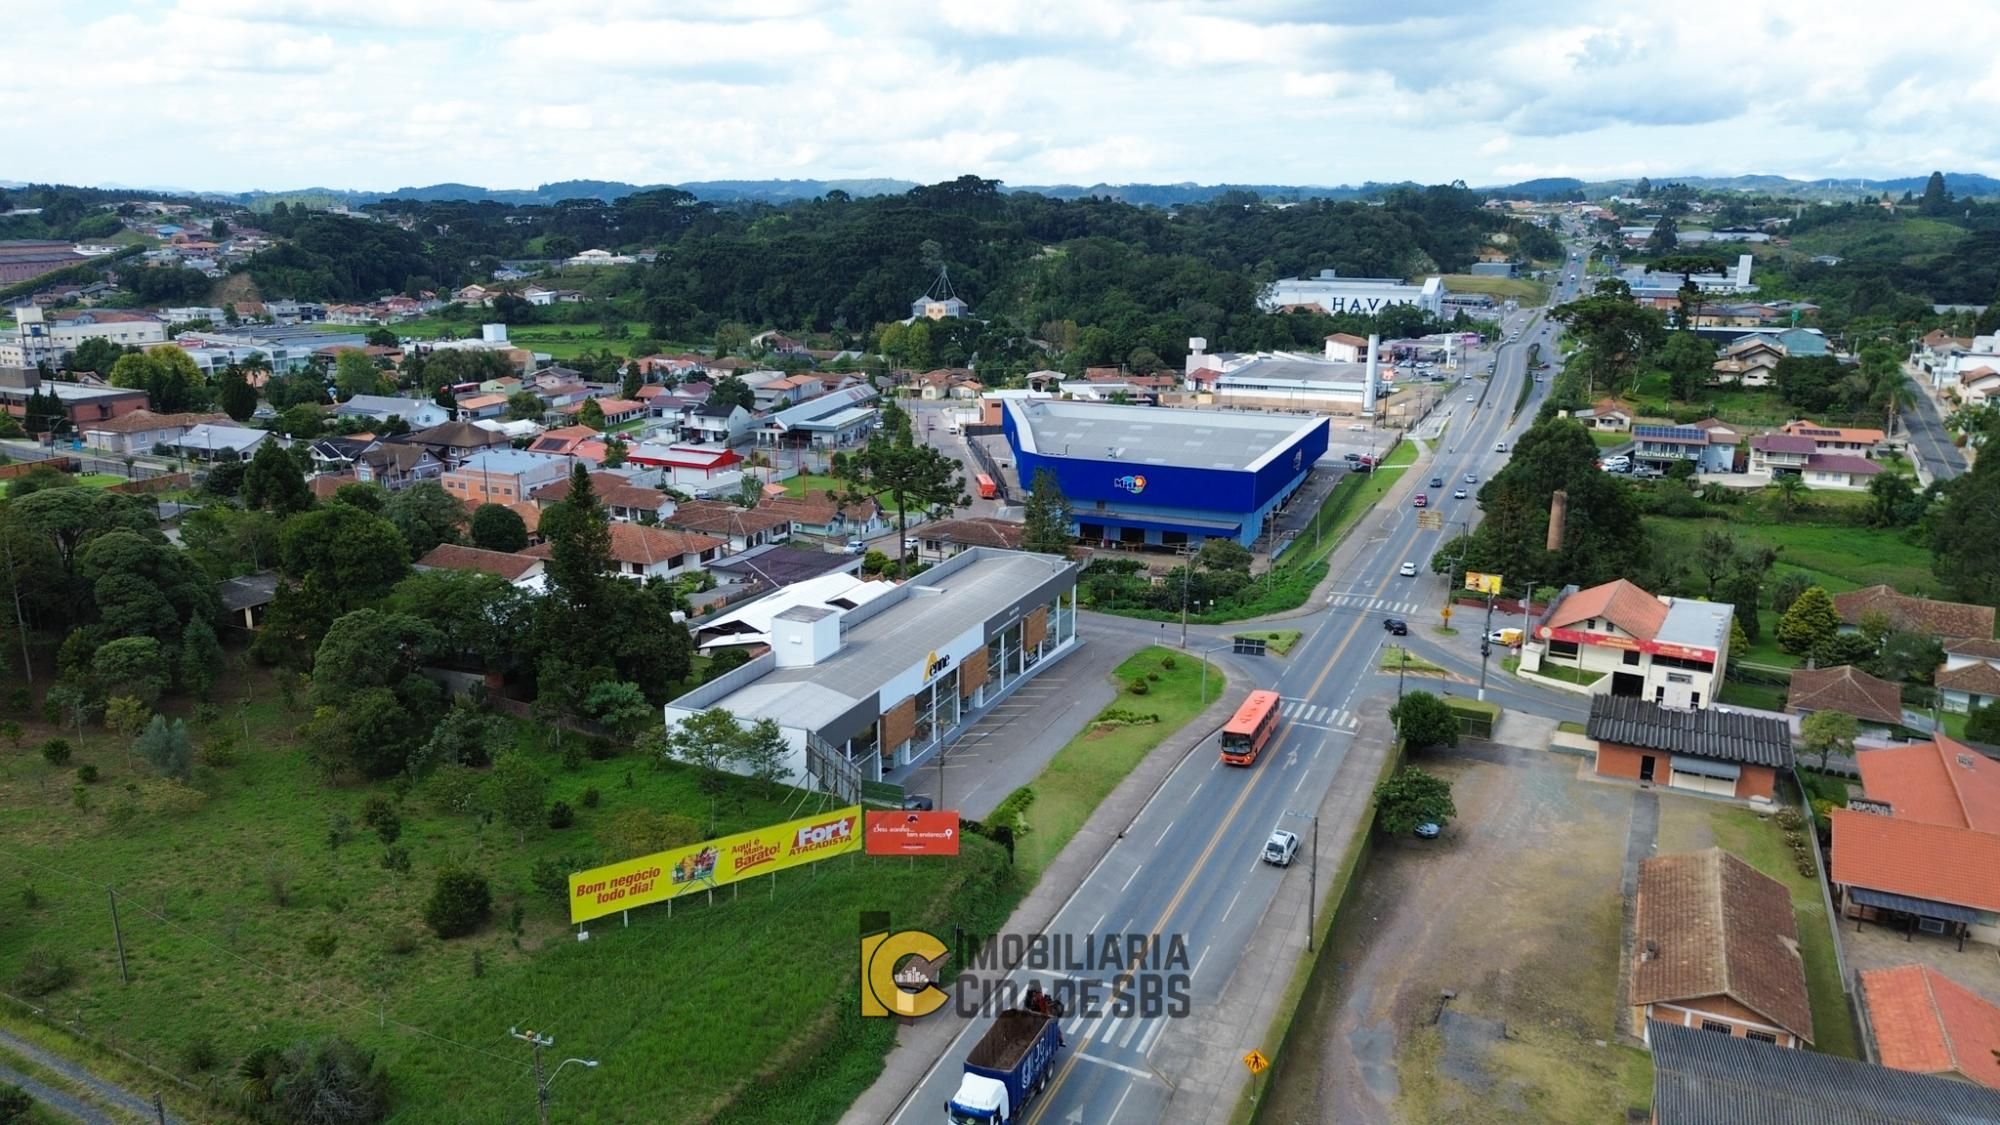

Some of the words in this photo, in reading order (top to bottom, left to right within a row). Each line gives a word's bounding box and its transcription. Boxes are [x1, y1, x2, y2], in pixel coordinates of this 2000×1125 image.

[1635, 451, 1684, 459] MULTIMARCAS
[798, 819, 849, 847] Fort
[731, 840, 751, 854] Aqui
[735, 842, 780, 869] Barato!
[744, 845, 764, 856] Mais
[788, 835, 852, 857] ATACADISTA
[576, 881, 606, 897] Bom
[610, 866, 660, 888] negócio
[597, 889, 625, 904] todo
[629, 879, 654, 896] dia!
